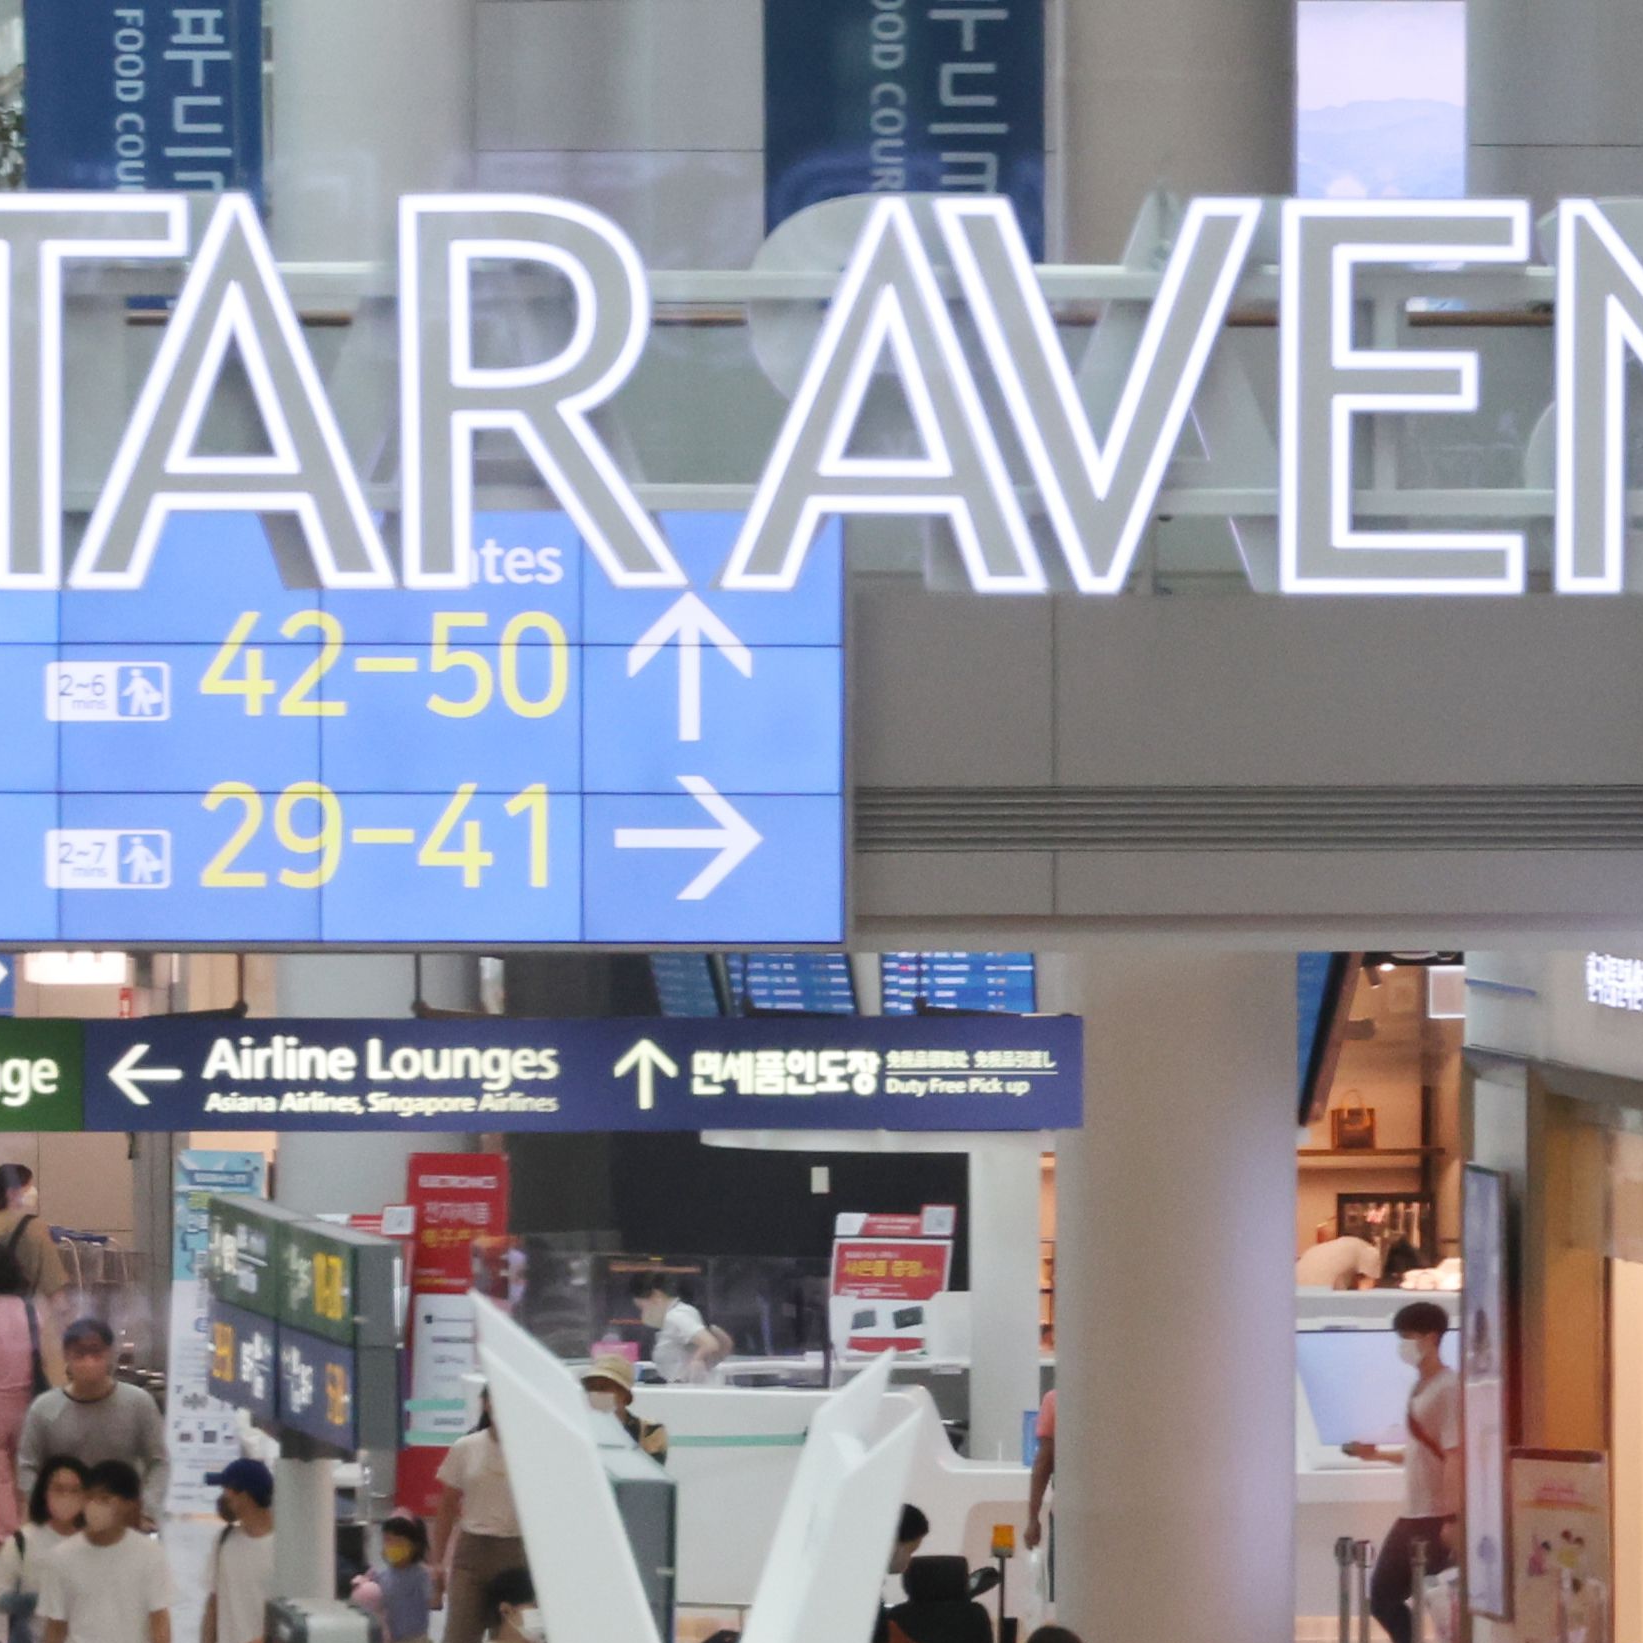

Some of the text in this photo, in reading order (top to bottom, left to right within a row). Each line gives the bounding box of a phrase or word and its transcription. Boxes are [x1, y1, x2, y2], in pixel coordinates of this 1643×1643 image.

[113, 9, 146, 190] FOOD COU
[469, 537, 564, 585] tes
[199, 610, 570, 719] 42-50
[72, 697, 108, 711] mins
[199, 781, 550, 889] 29-41
[201, 1036, 560, 1090] Airline Lounges
[886, 1077, 1031, 1097] Duty Free Pick up
[205, 1092, 276, 1113] Asiana
[367, 1091, 478, 1117] Singapore
[478, 1092, 560, 1113] Airlines
